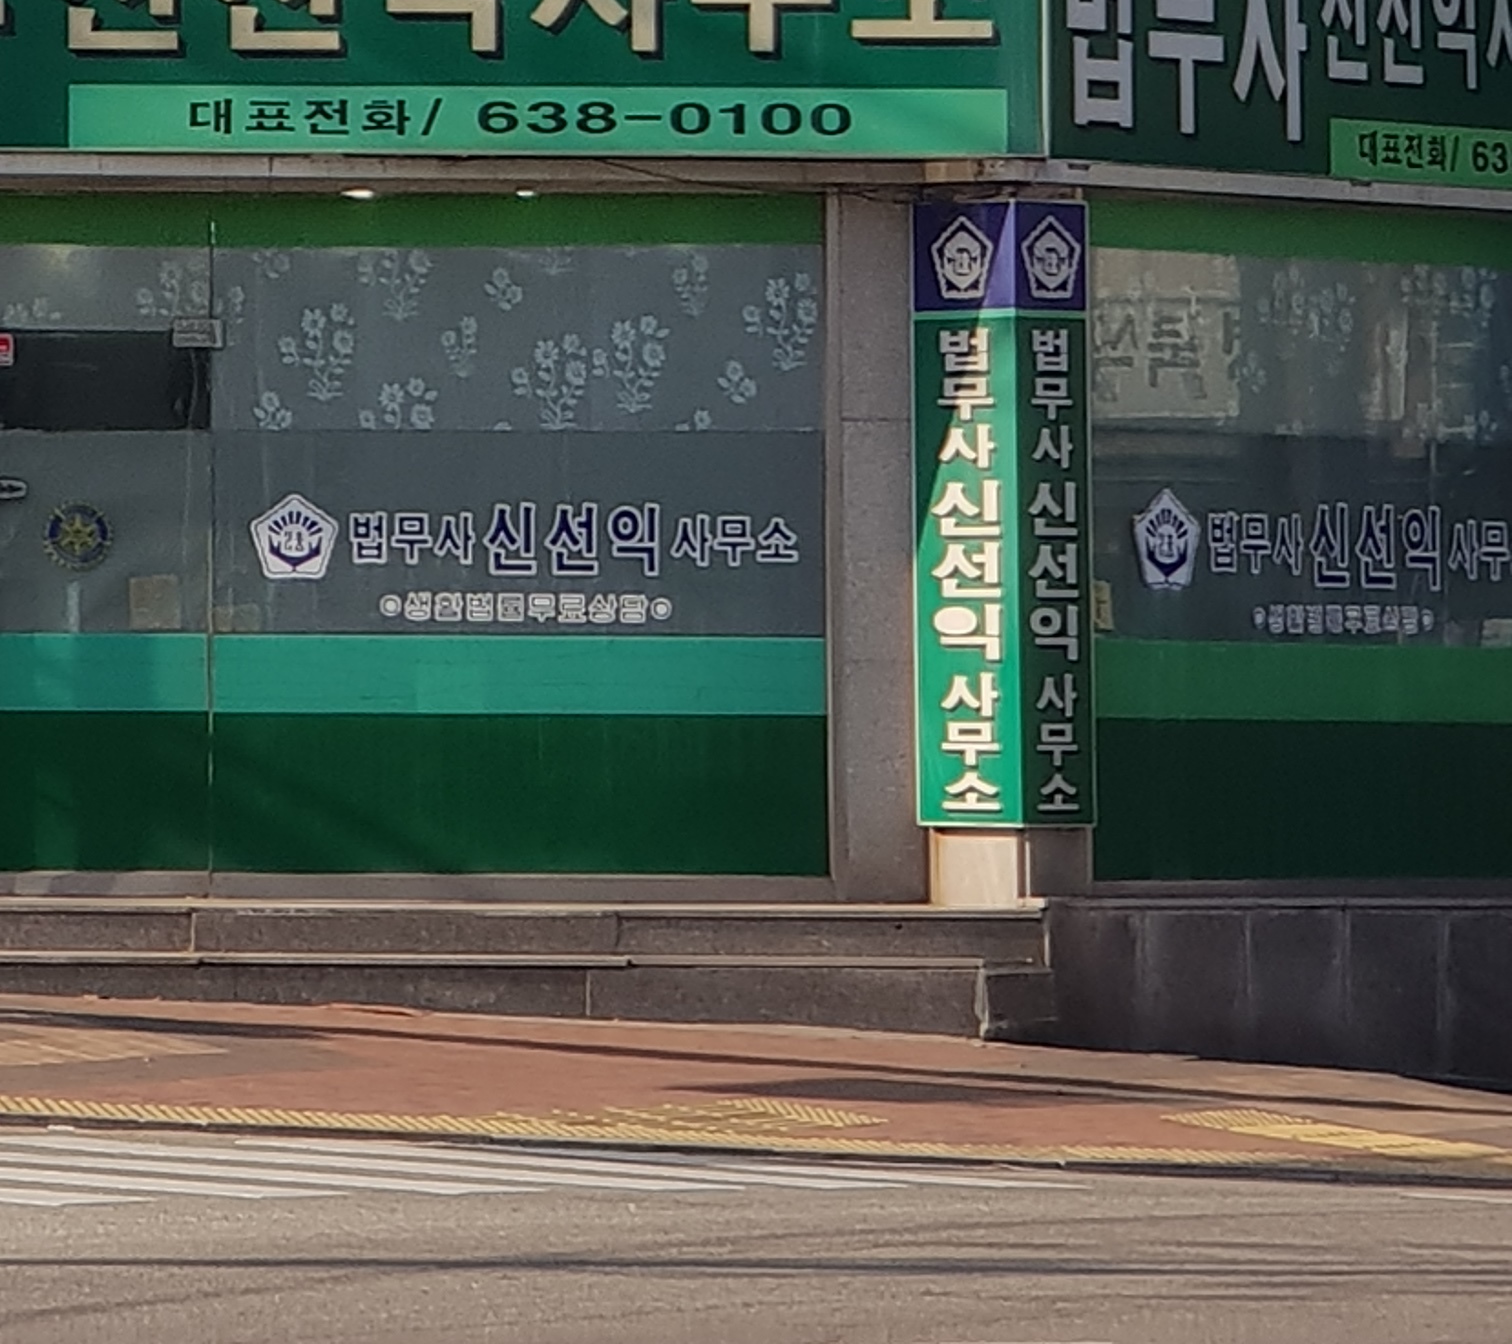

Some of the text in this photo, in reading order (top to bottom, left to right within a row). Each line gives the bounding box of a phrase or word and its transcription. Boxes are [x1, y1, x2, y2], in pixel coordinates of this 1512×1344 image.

[476, 100, 853, 138] 638-0100
[349, 500, 800, 577] 법무사 신선익 사무소
[931, 327, 1004, 811] 법무사 신선익 사무소
[1028, 328, 1080, 811] 법무사 신선익 사무소
[1207, 511, 1304, 576] 법무사
[1309, 502, 1441, 592] 신선익
